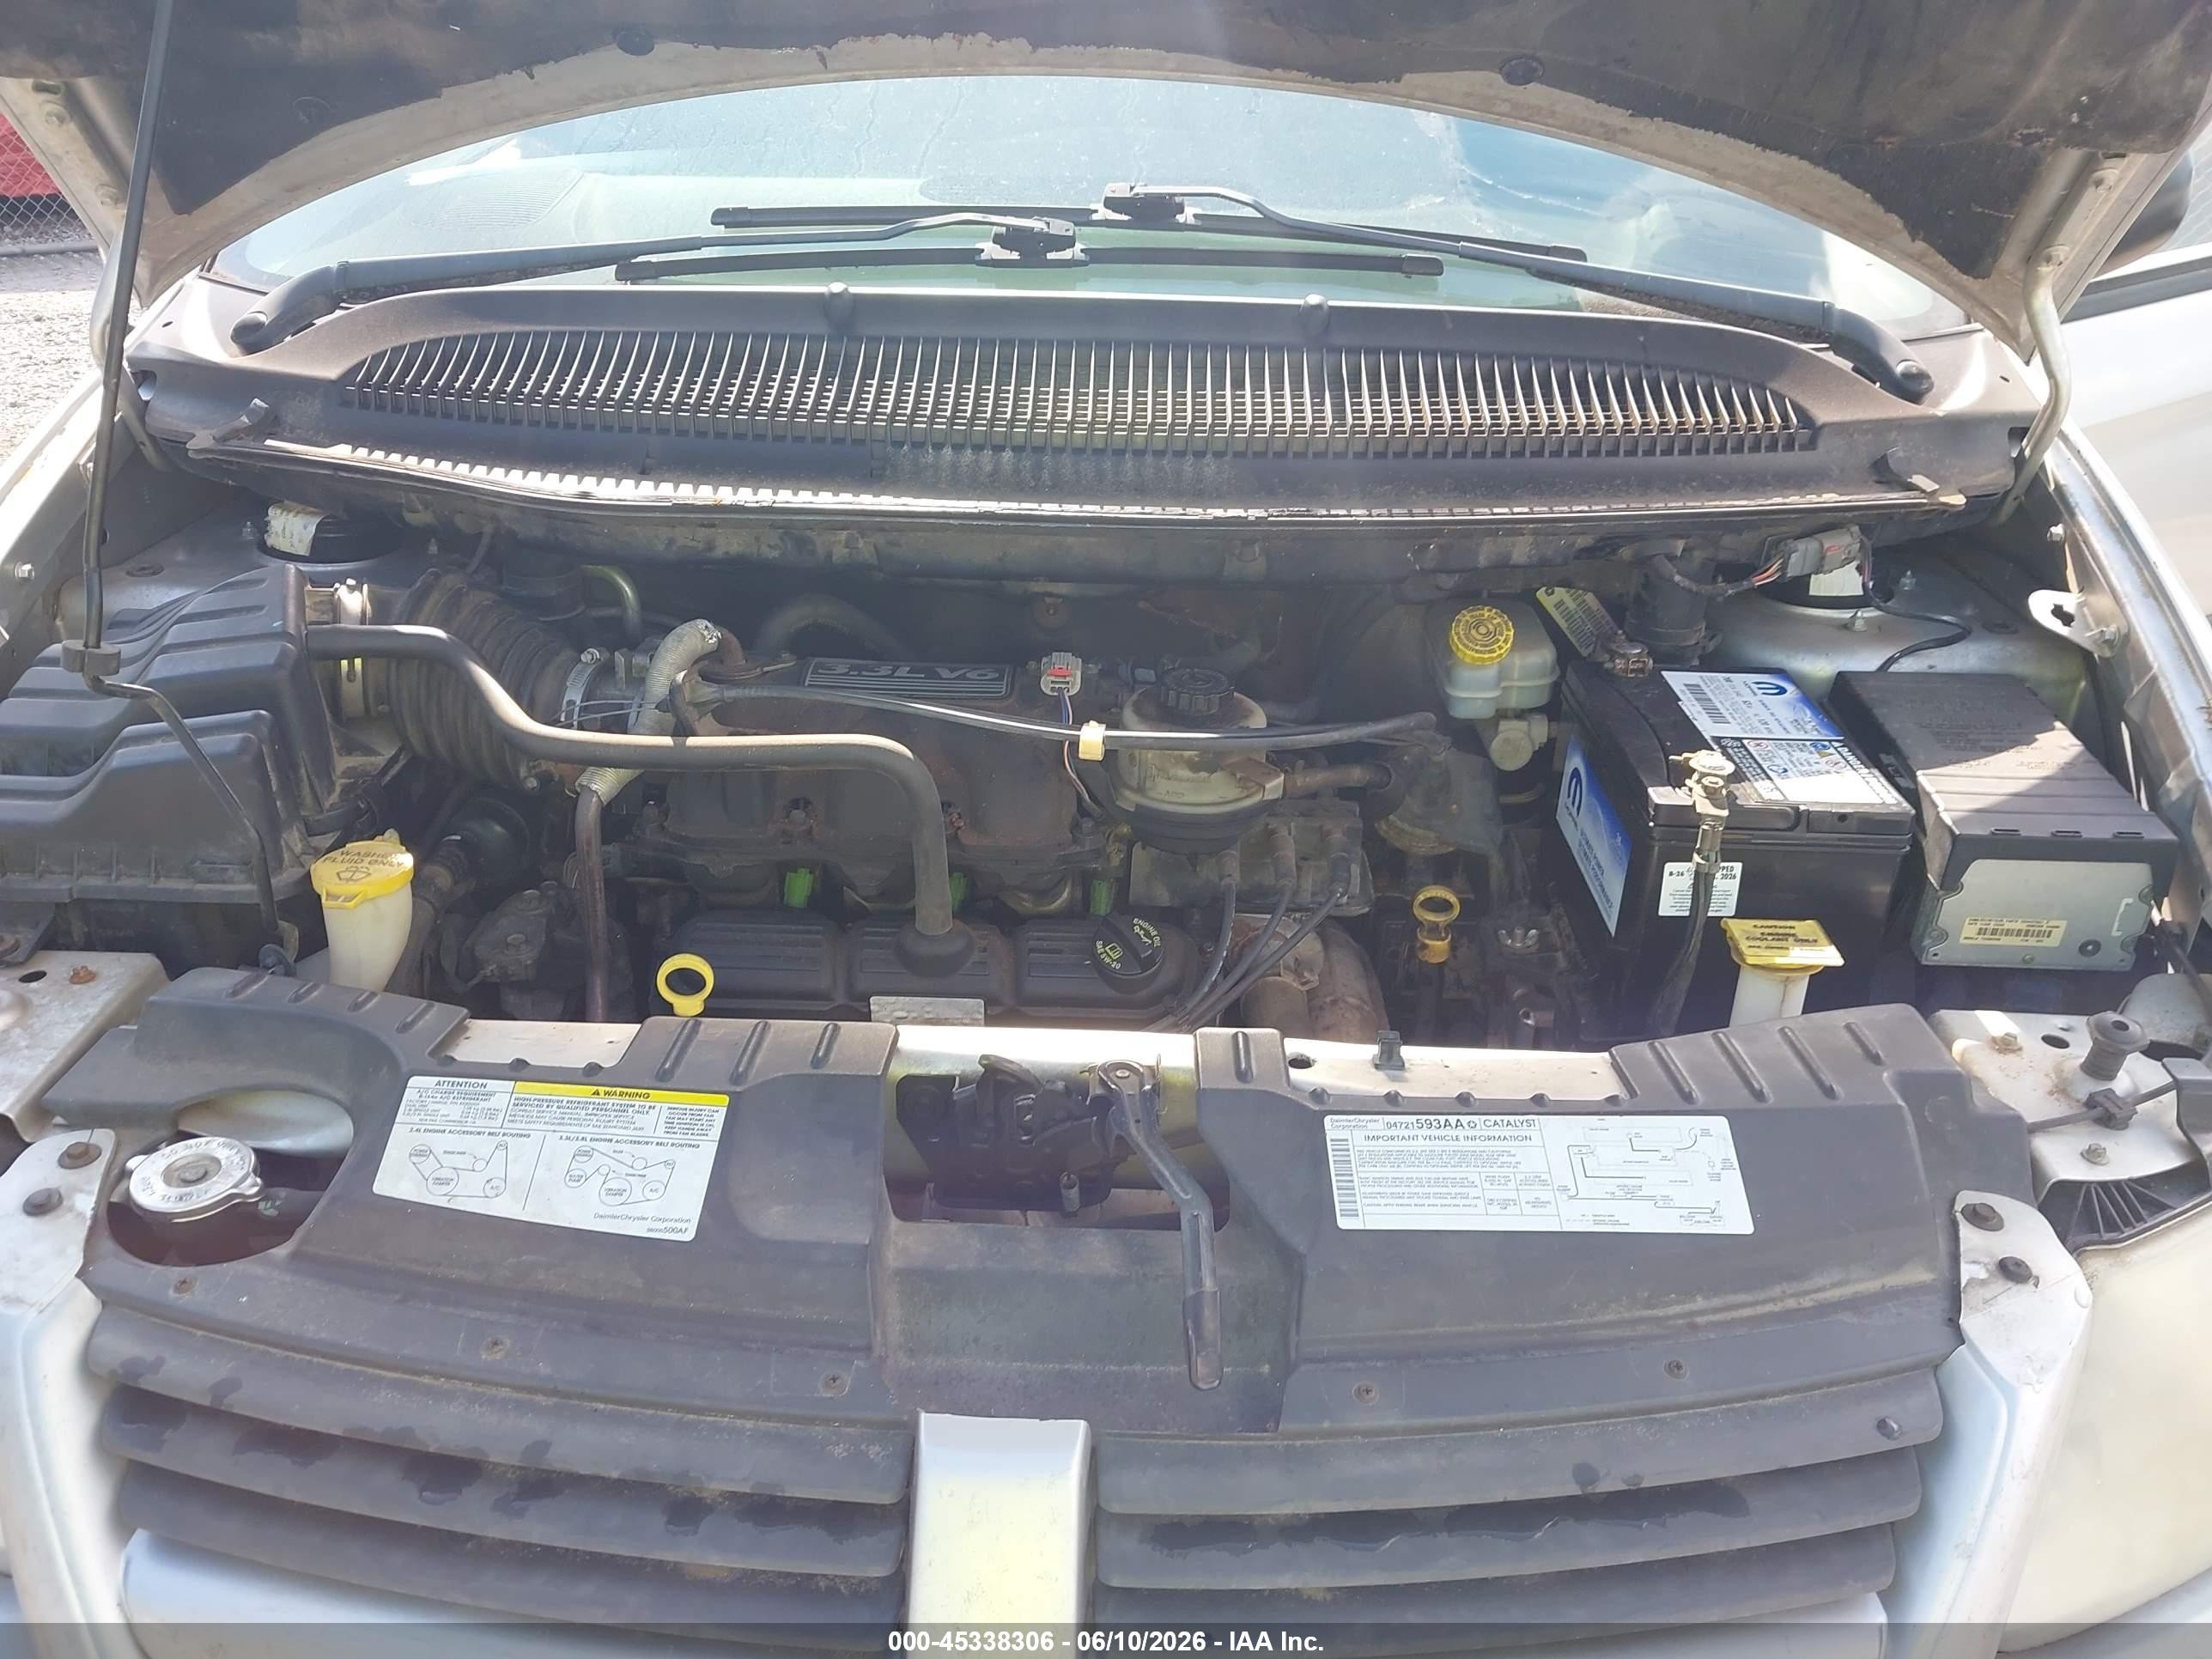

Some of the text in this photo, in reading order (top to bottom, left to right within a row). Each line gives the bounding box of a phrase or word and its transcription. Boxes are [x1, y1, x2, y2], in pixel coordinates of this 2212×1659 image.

[817, 663, 1000, 680] 3.3L V6
[368, 859, 404, 867] ONLY
[1133, 918, 1162, 948] ENGINE OIL
[1096, 940, 1105, 955] SAE
[434, 1079, 488, 1090] ATTENTION
[603, 1090, 651, 1100] WARNING
[1483, 1119, 1536, 1128] CATALYST
[593, 1212, 691, 1224] DaimlerChrysler Corporation
